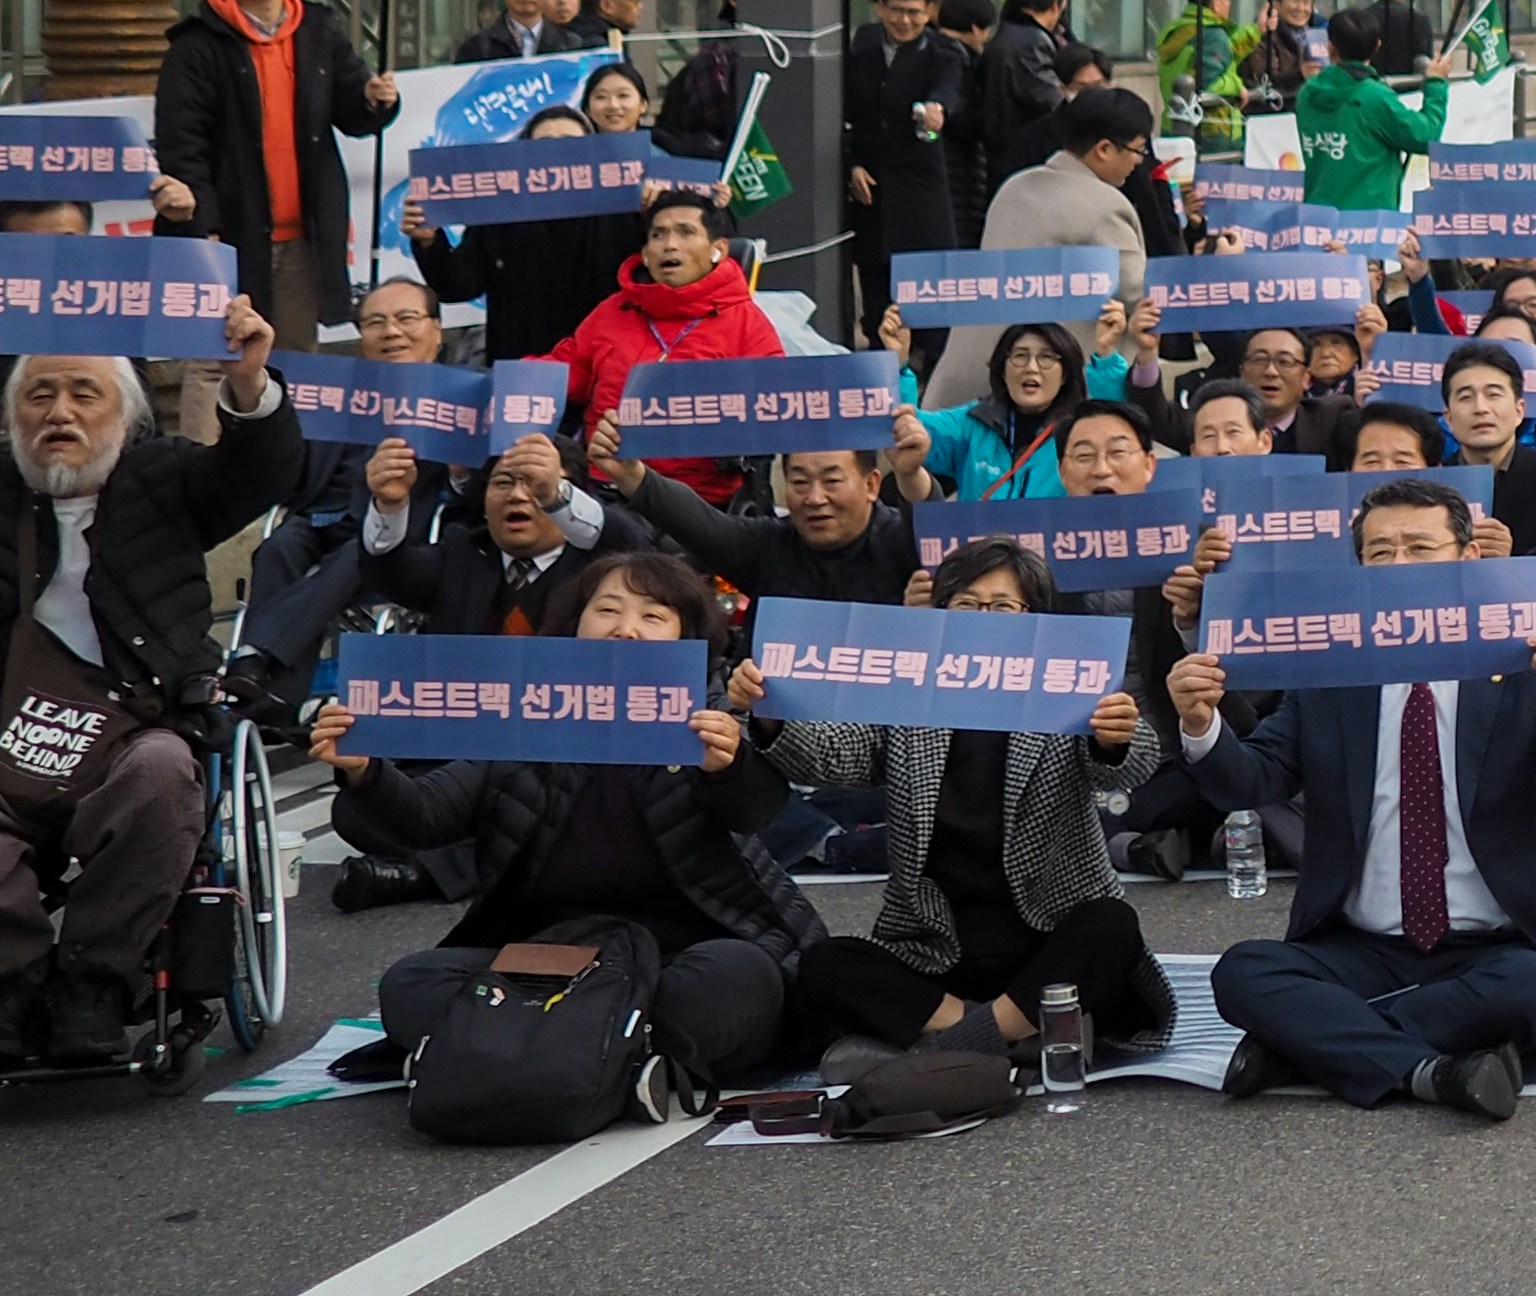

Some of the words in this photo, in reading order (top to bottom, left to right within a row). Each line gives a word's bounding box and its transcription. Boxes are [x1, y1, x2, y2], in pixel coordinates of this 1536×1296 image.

[40, 146, 115, 173] 선거법
[409, 170, 520, 202] 패스트트랙
[526, 164, 593, 193] 선거법
[599, 160, 646, 188] 통과
[1415, 212, 1508, 236] 패스트트랙
[52, 280, 150, 317] 선거법
[161, 282, 233, 319] 통과
[897, 276, 998, 303] 패스트트랙
[1004, 273, 1064, 300] 선거법
[1070, 271, 1112, 298] 통과
[1149, 280, 1250, 309] 패스트트랙
[1256, 278, 1316, 304] 선거법
[1322, 276, 1363, 301] 통과
[503, 394, 556, 425] 통과
[619, 393, 746, 427] 패스트트랙
[755, 390, 830, 421] 선거법
[839, 386, 894, 418] 통과
[1052, 529, 1128, 562] 선거법
[1136, 525, 1190, 557] 통과
[1206, 612, 1362, 655] 패스트트랙
[1370, 606, 1468, 647] 선거법
[761, 642, 929, 687] 패스트트랙
[935, 653, 1033, 692] 선거법
[1042, 658, 1111, 695] 통과
[20, 695, 109, 735] LEAVE
[347, 680, 511, 719] 패스트트랙
[520, 683, 615, 721] 선거법
[626, 685, 693, 723] 통과
[0, 730, 83, 771] BEHIND
